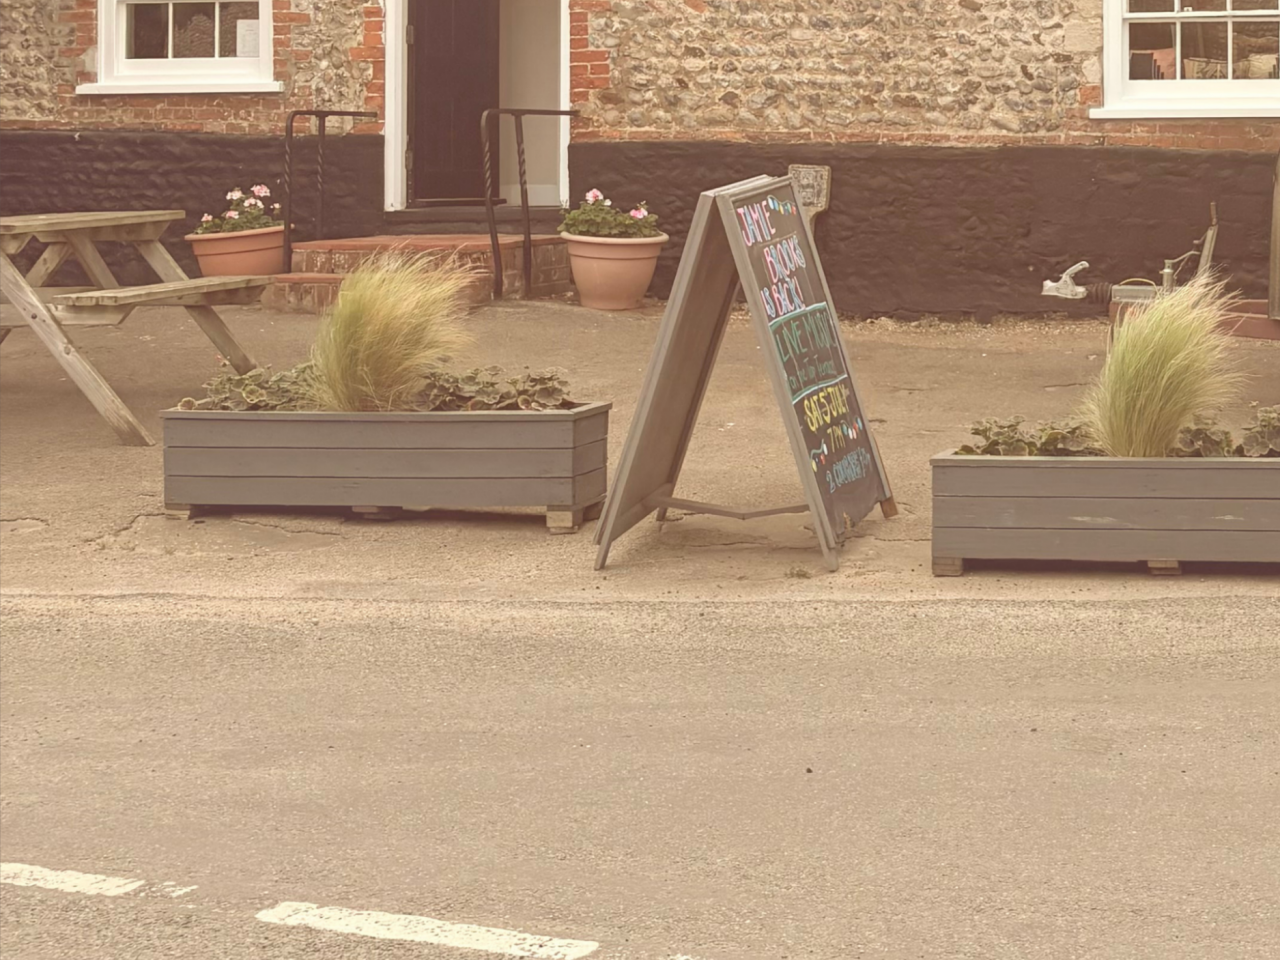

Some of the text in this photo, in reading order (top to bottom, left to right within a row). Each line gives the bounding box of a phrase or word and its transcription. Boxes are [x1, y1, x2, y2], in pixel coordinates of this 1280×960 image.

[737, 200, 776, 247] JAMIE
[763, 235, 806, 284] BROOKS
[761, 286, 776, 318] IS
[776, 319, 808, 363] LIVE
[804, 394, 823, 432] SAT
[827, 383, 849, 418] JULY
